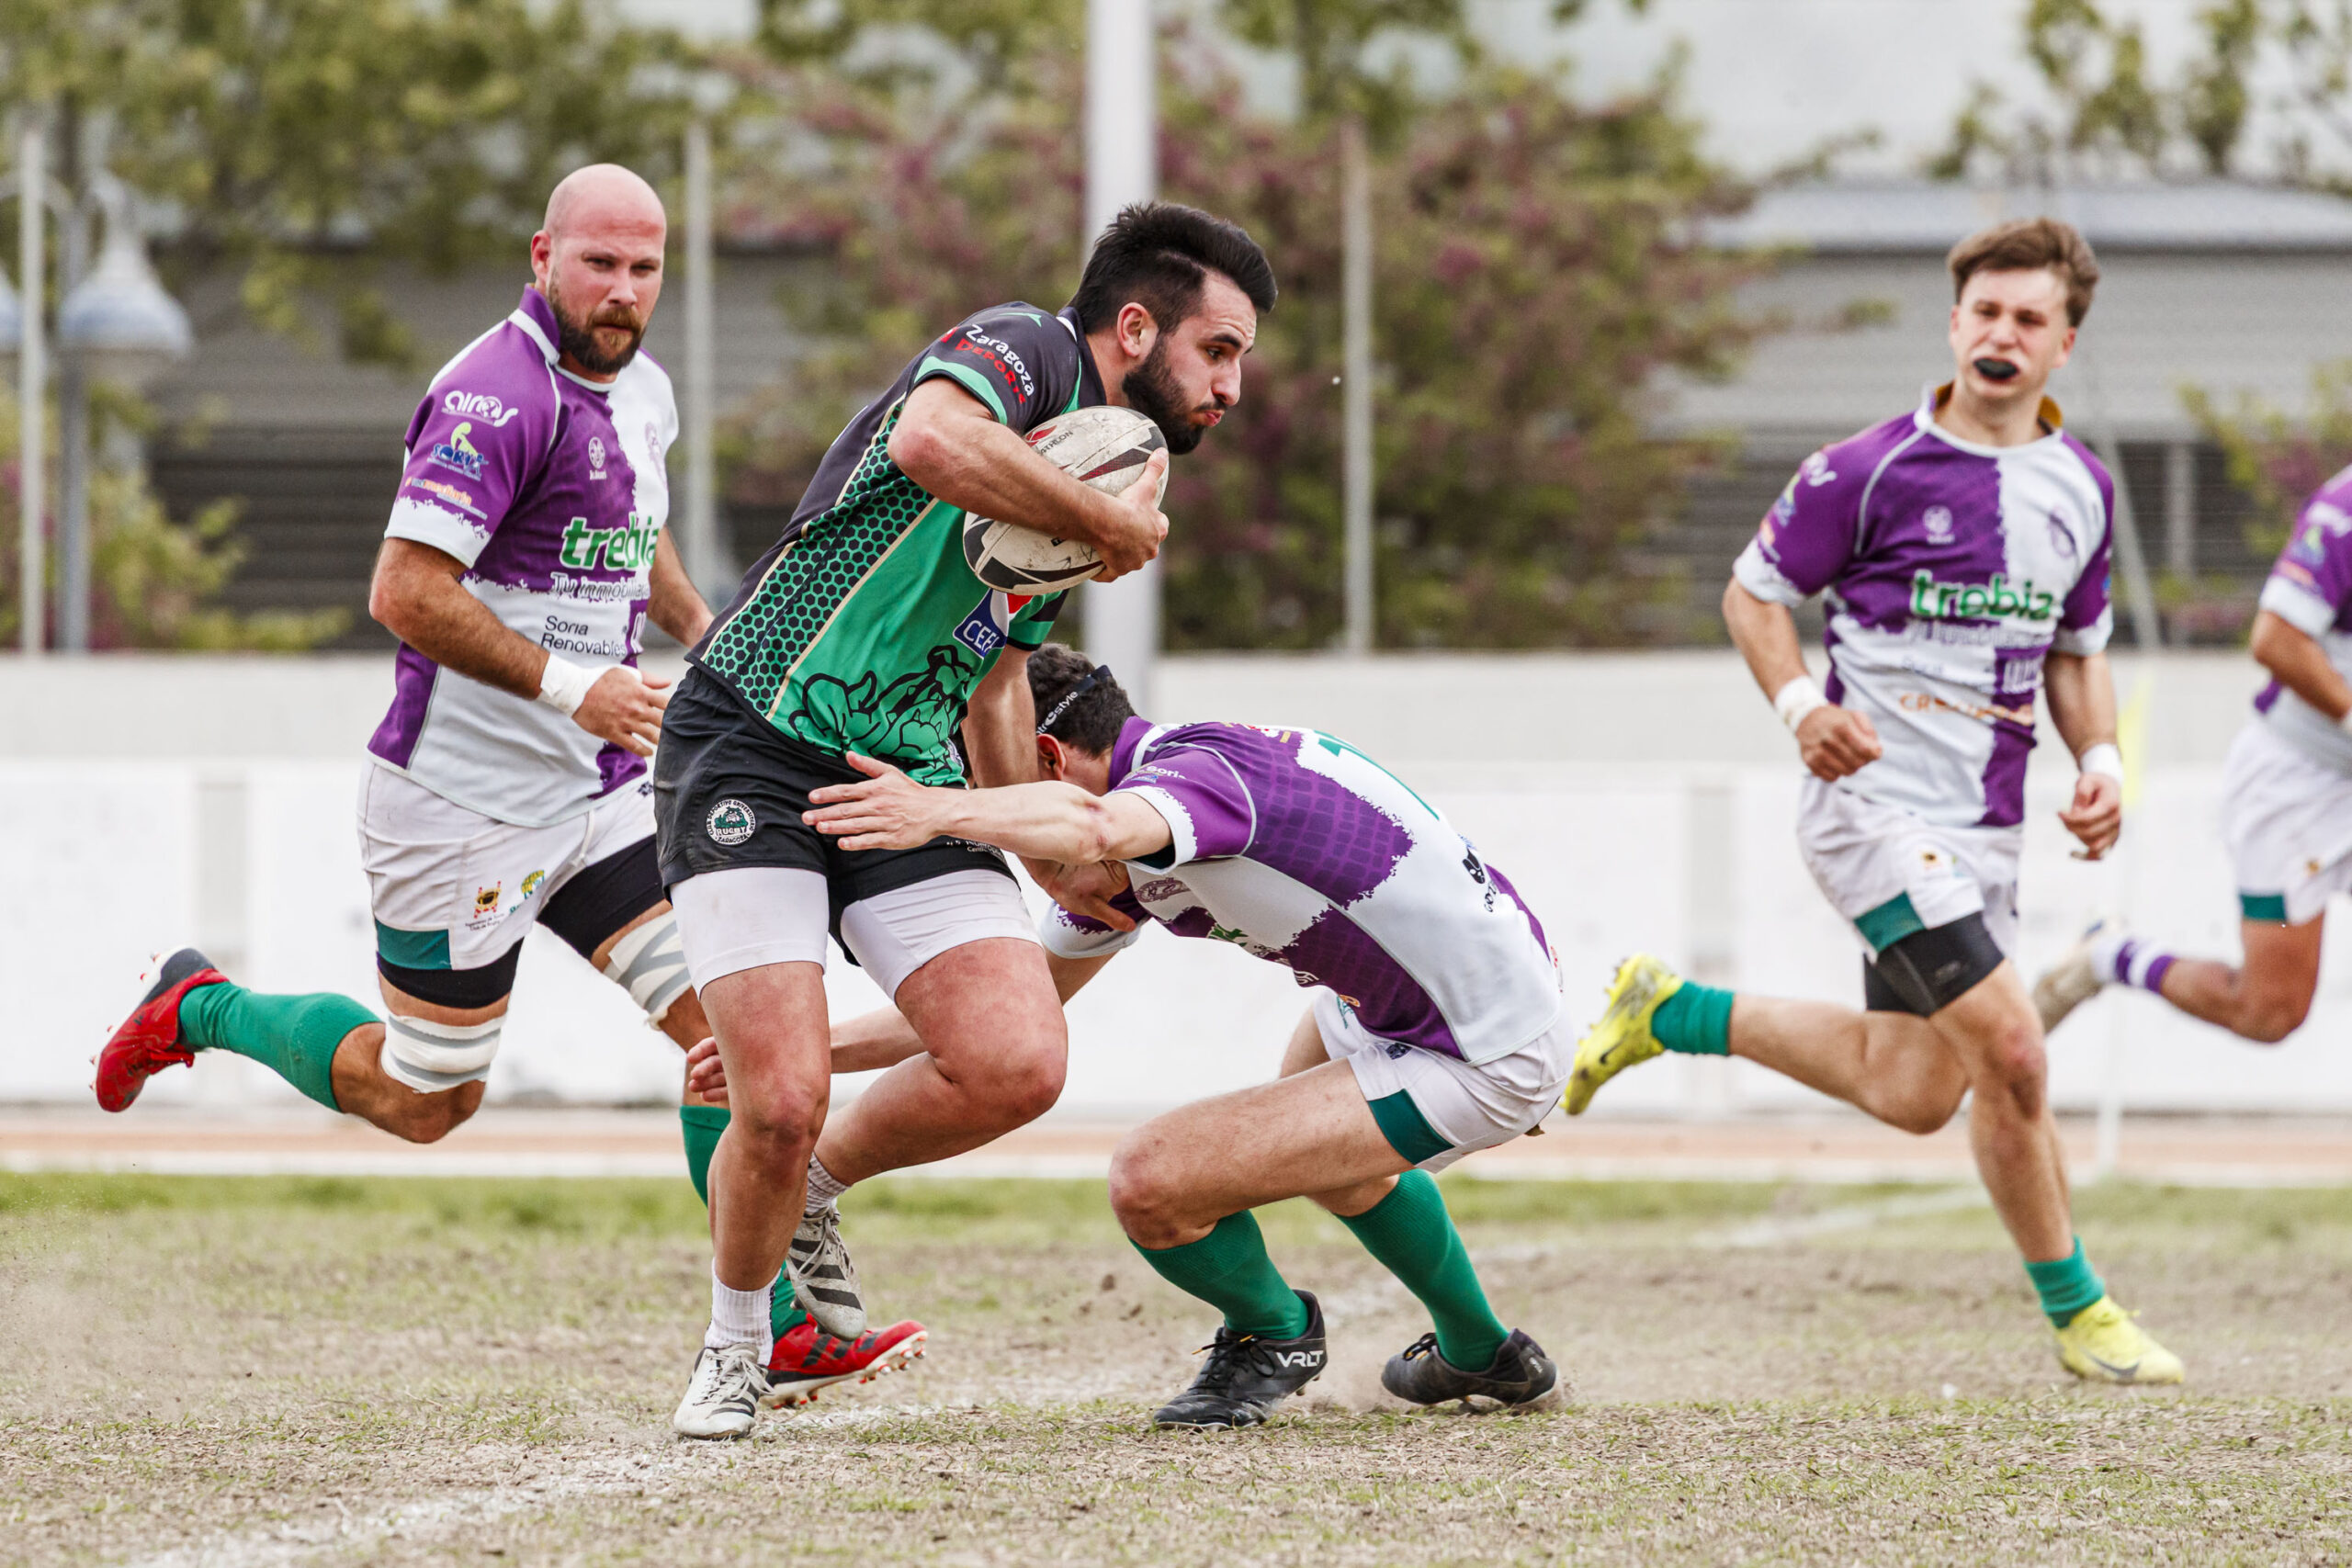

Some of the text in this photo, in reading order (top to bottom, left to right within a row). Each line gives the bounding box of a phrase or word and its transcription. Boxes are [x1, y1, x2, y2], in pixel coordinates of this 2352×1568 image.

[966, 324, 1035, 397] Zaragoza
[1039, 430, 1074, 456] ATHLON
[561, 514, 659, 570] trebia
[544, 615, 589, 636] Soria
[540, 632, 628, 657] Renovables
